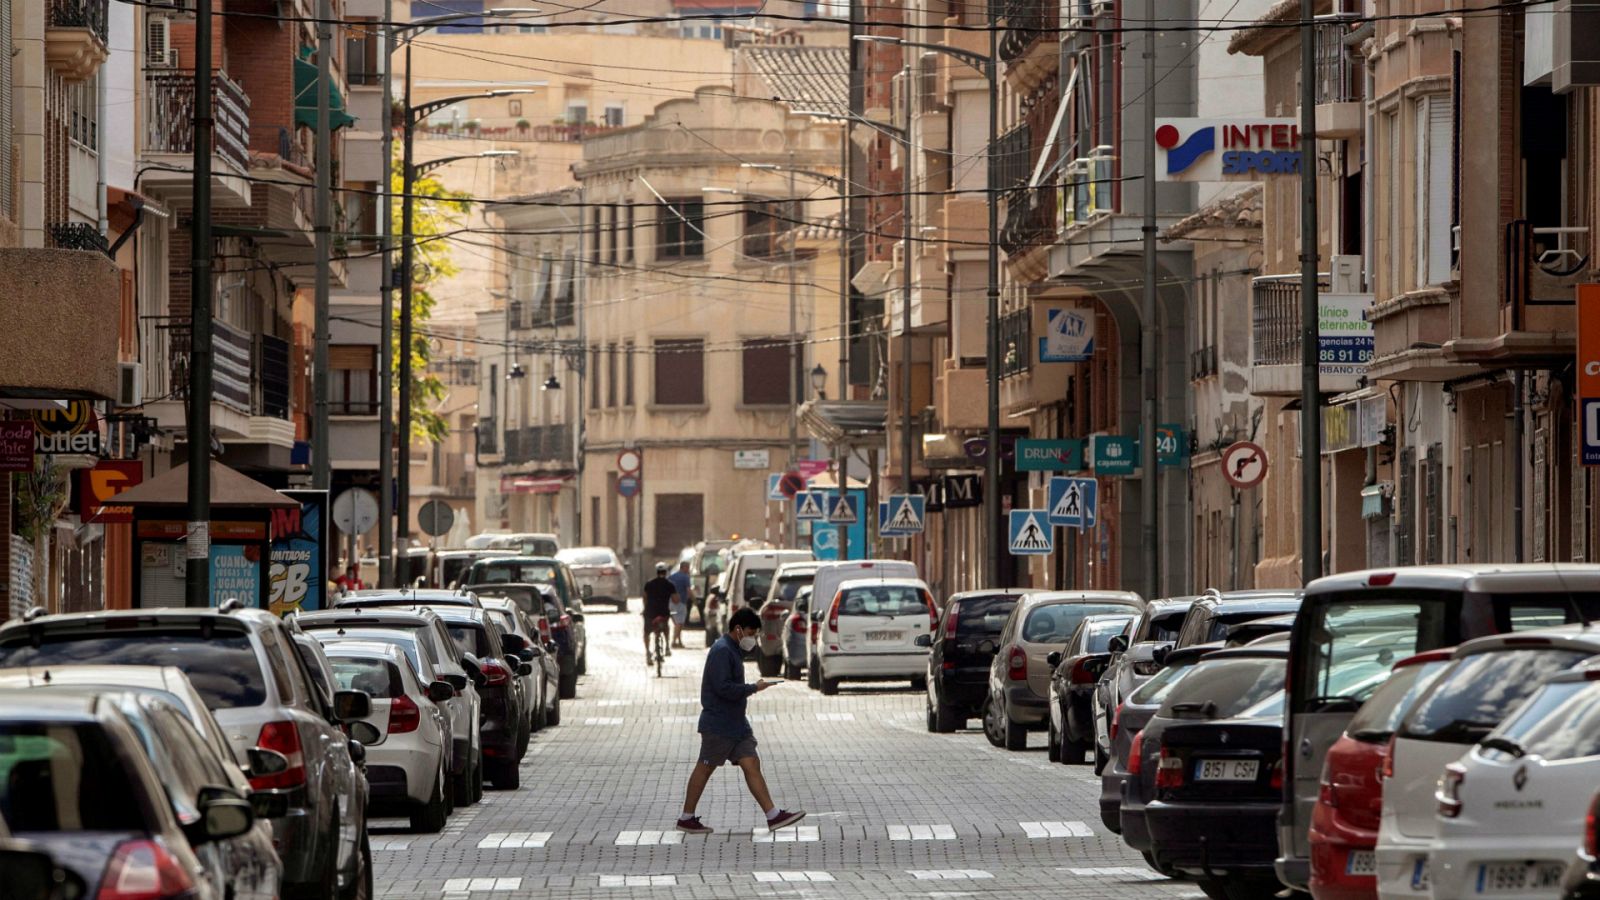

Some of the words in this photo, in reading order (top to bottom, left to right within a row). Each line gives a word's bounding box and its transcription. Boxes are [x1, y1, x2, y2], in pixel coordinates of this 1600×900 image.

[1320, 306, 1348, 317] línica
[1320, 320, 1368, 330] eterinaria
[1319, 338, 1353, 346] gencias
[1355, 338, 1365, 346] 24
[1339, 350, 1353, 361] 91
[1320, 366, 1353, 374] RBANO
[1024, 447, 1062, 459] DRUNI
[1203, 762, 1226, 777] 8151
[1233, 762, 1257, 777] CSH
